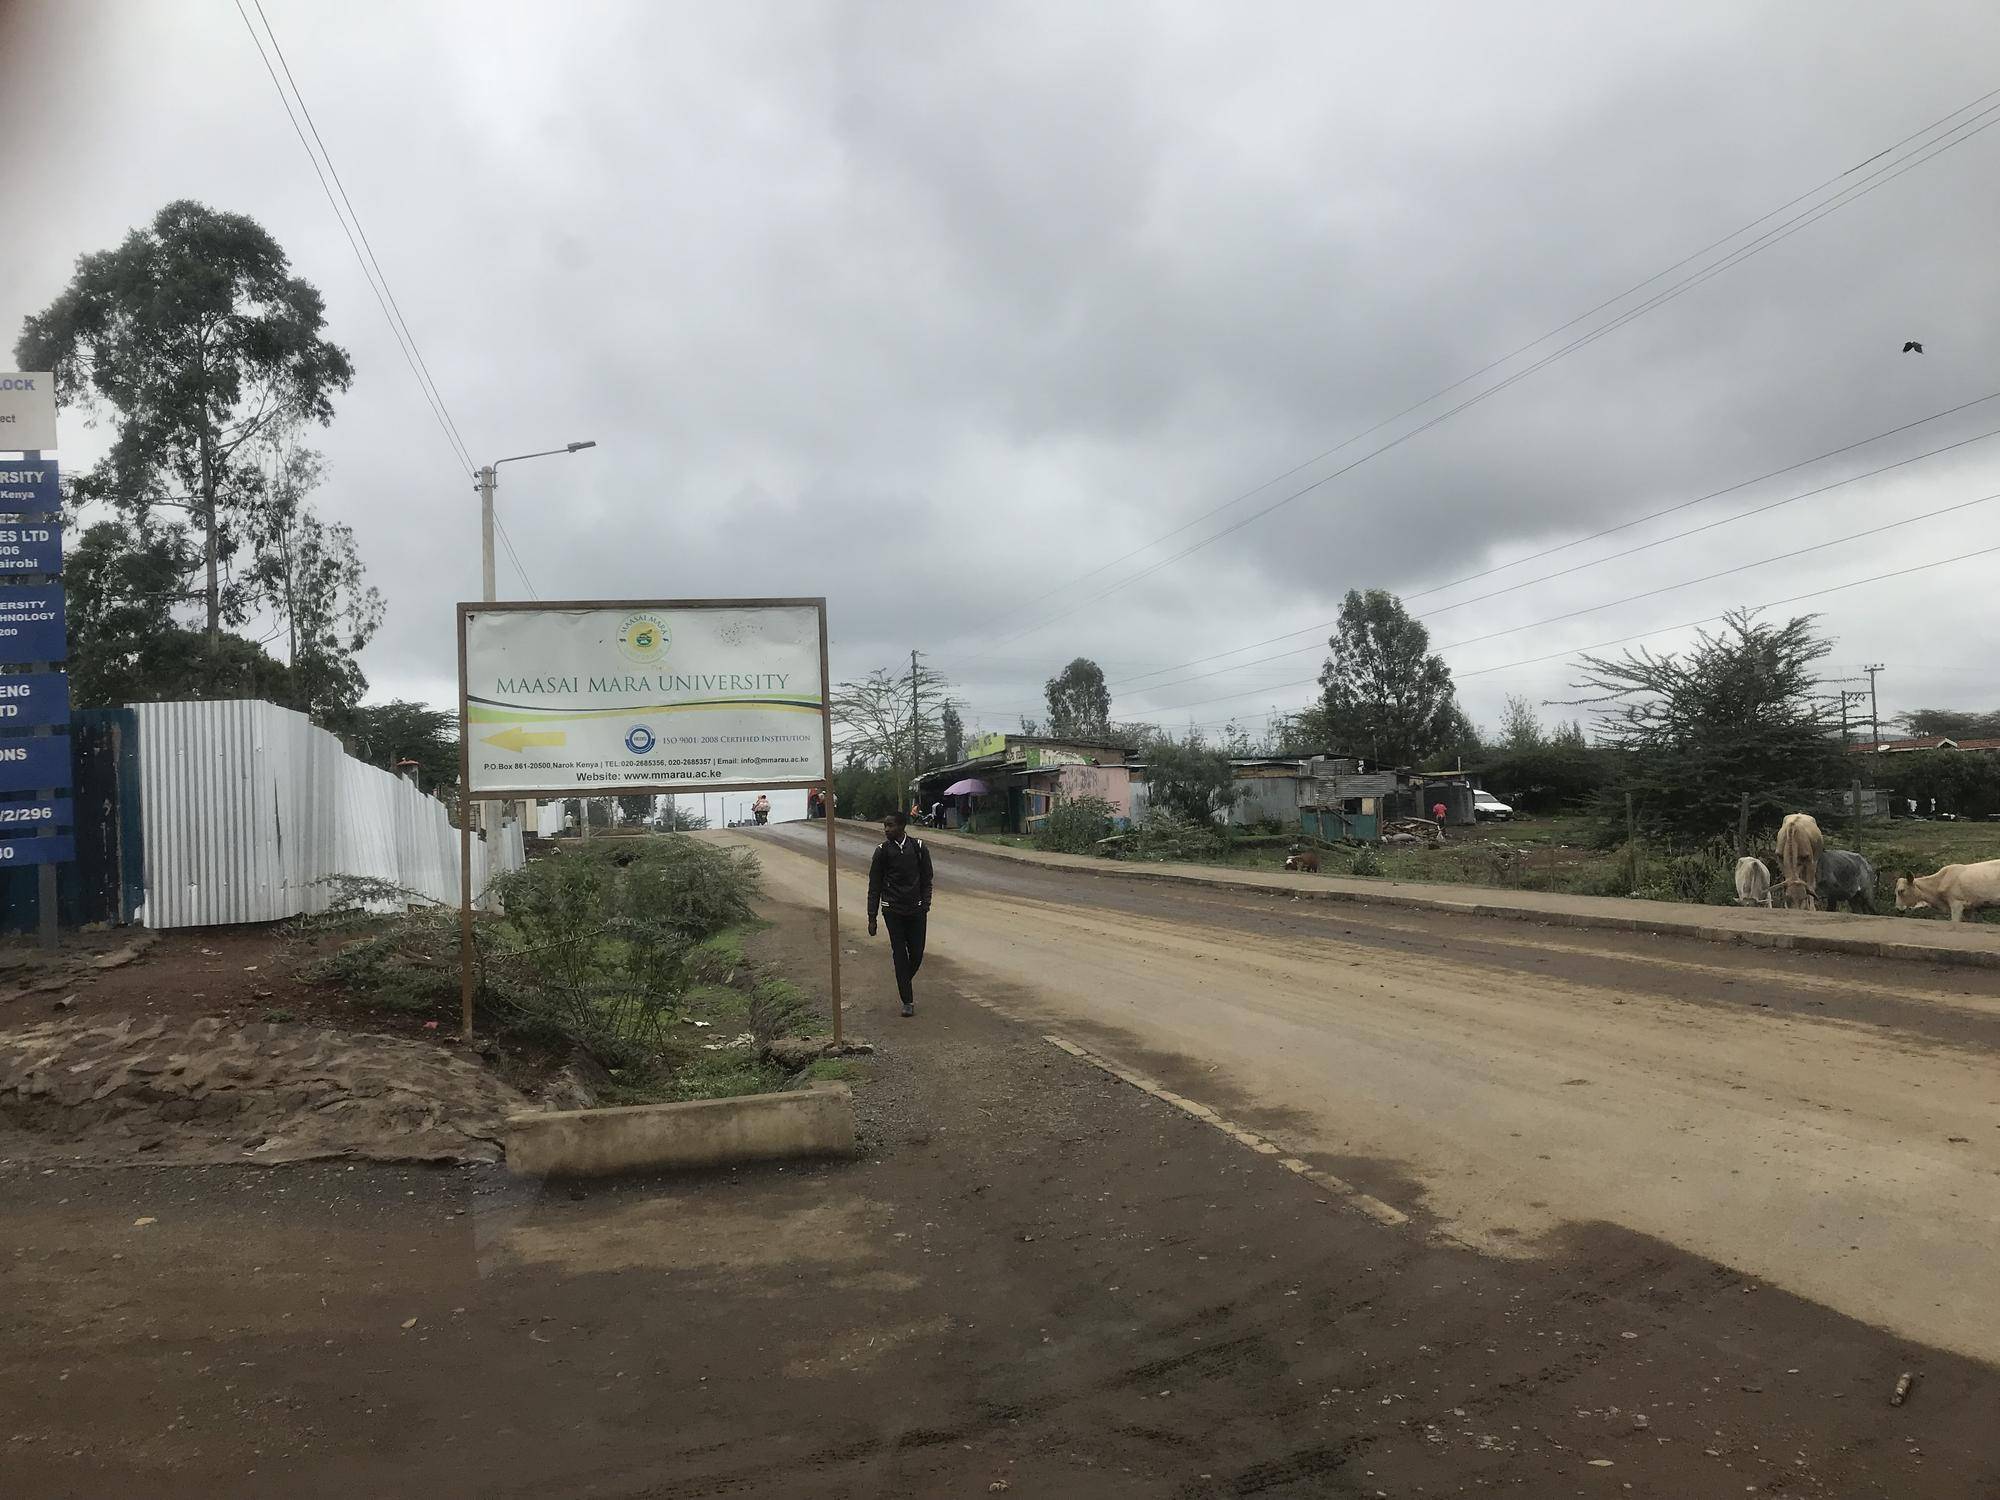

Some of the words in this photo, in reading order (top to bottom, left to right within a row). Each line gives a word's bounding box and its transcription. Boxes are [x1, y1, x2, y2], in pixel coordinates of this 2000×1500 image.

[0, 379, 35, 391] OCK
[0, 414, 16, 423] ect
[0, 471, 45, 483] RSITY
[0, 490, 35, 501] Kenya
[0, 530, 17, 542] ES
[21, 530, 49, 542] LTD
[0, 546, 20, 555] 06
[0, 559, 38, 568] airobi
[0, 600, 46, 610] ERSITY
[496, 677, 578, 694] MAASAI
[588, 676, 651, 692] MARA
[658, 673, 790, 692] UNIVERSITY
[0, 684, 30, 698] ENG
[663, 737, 678, 745] ISO
[700, 736, 719, 744] 2008
[720, 735, 760, 743] CERTIFIED
[761, 734, 811, 742] INSTITUTION
[576, 761, 599, 770] Kenya
[668, 758, 711, 766] 020-2685357
[740, 755, 809, 765] info@mmarau.ac.ke
[576, 771, 621, 782] Website:
[624, 769, 722, 780] www.mmarau.ac.ke
[0, 847, 14, 859] 0
